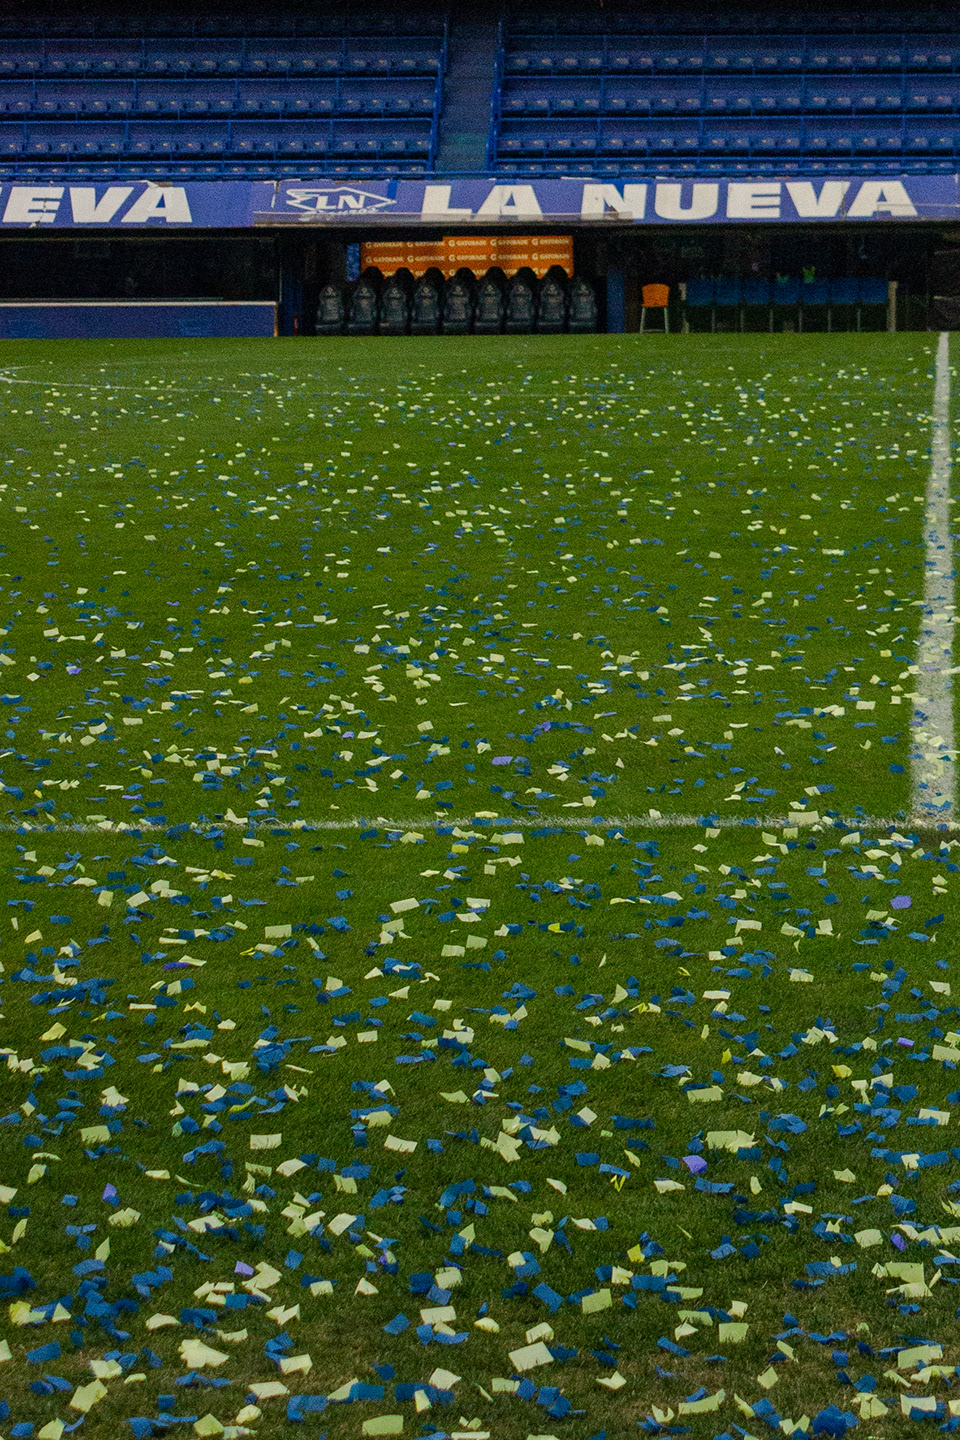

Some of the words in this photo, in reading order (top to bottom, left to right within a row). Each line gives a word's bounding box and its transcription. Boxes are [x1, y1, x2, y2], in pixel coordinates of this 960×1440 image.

[0, 187, 193, 223] EVA
[316, 195, 365, 209] LN
[421, 184, 544, 222] LA
[580, 180, 918, 220] NUEVA
